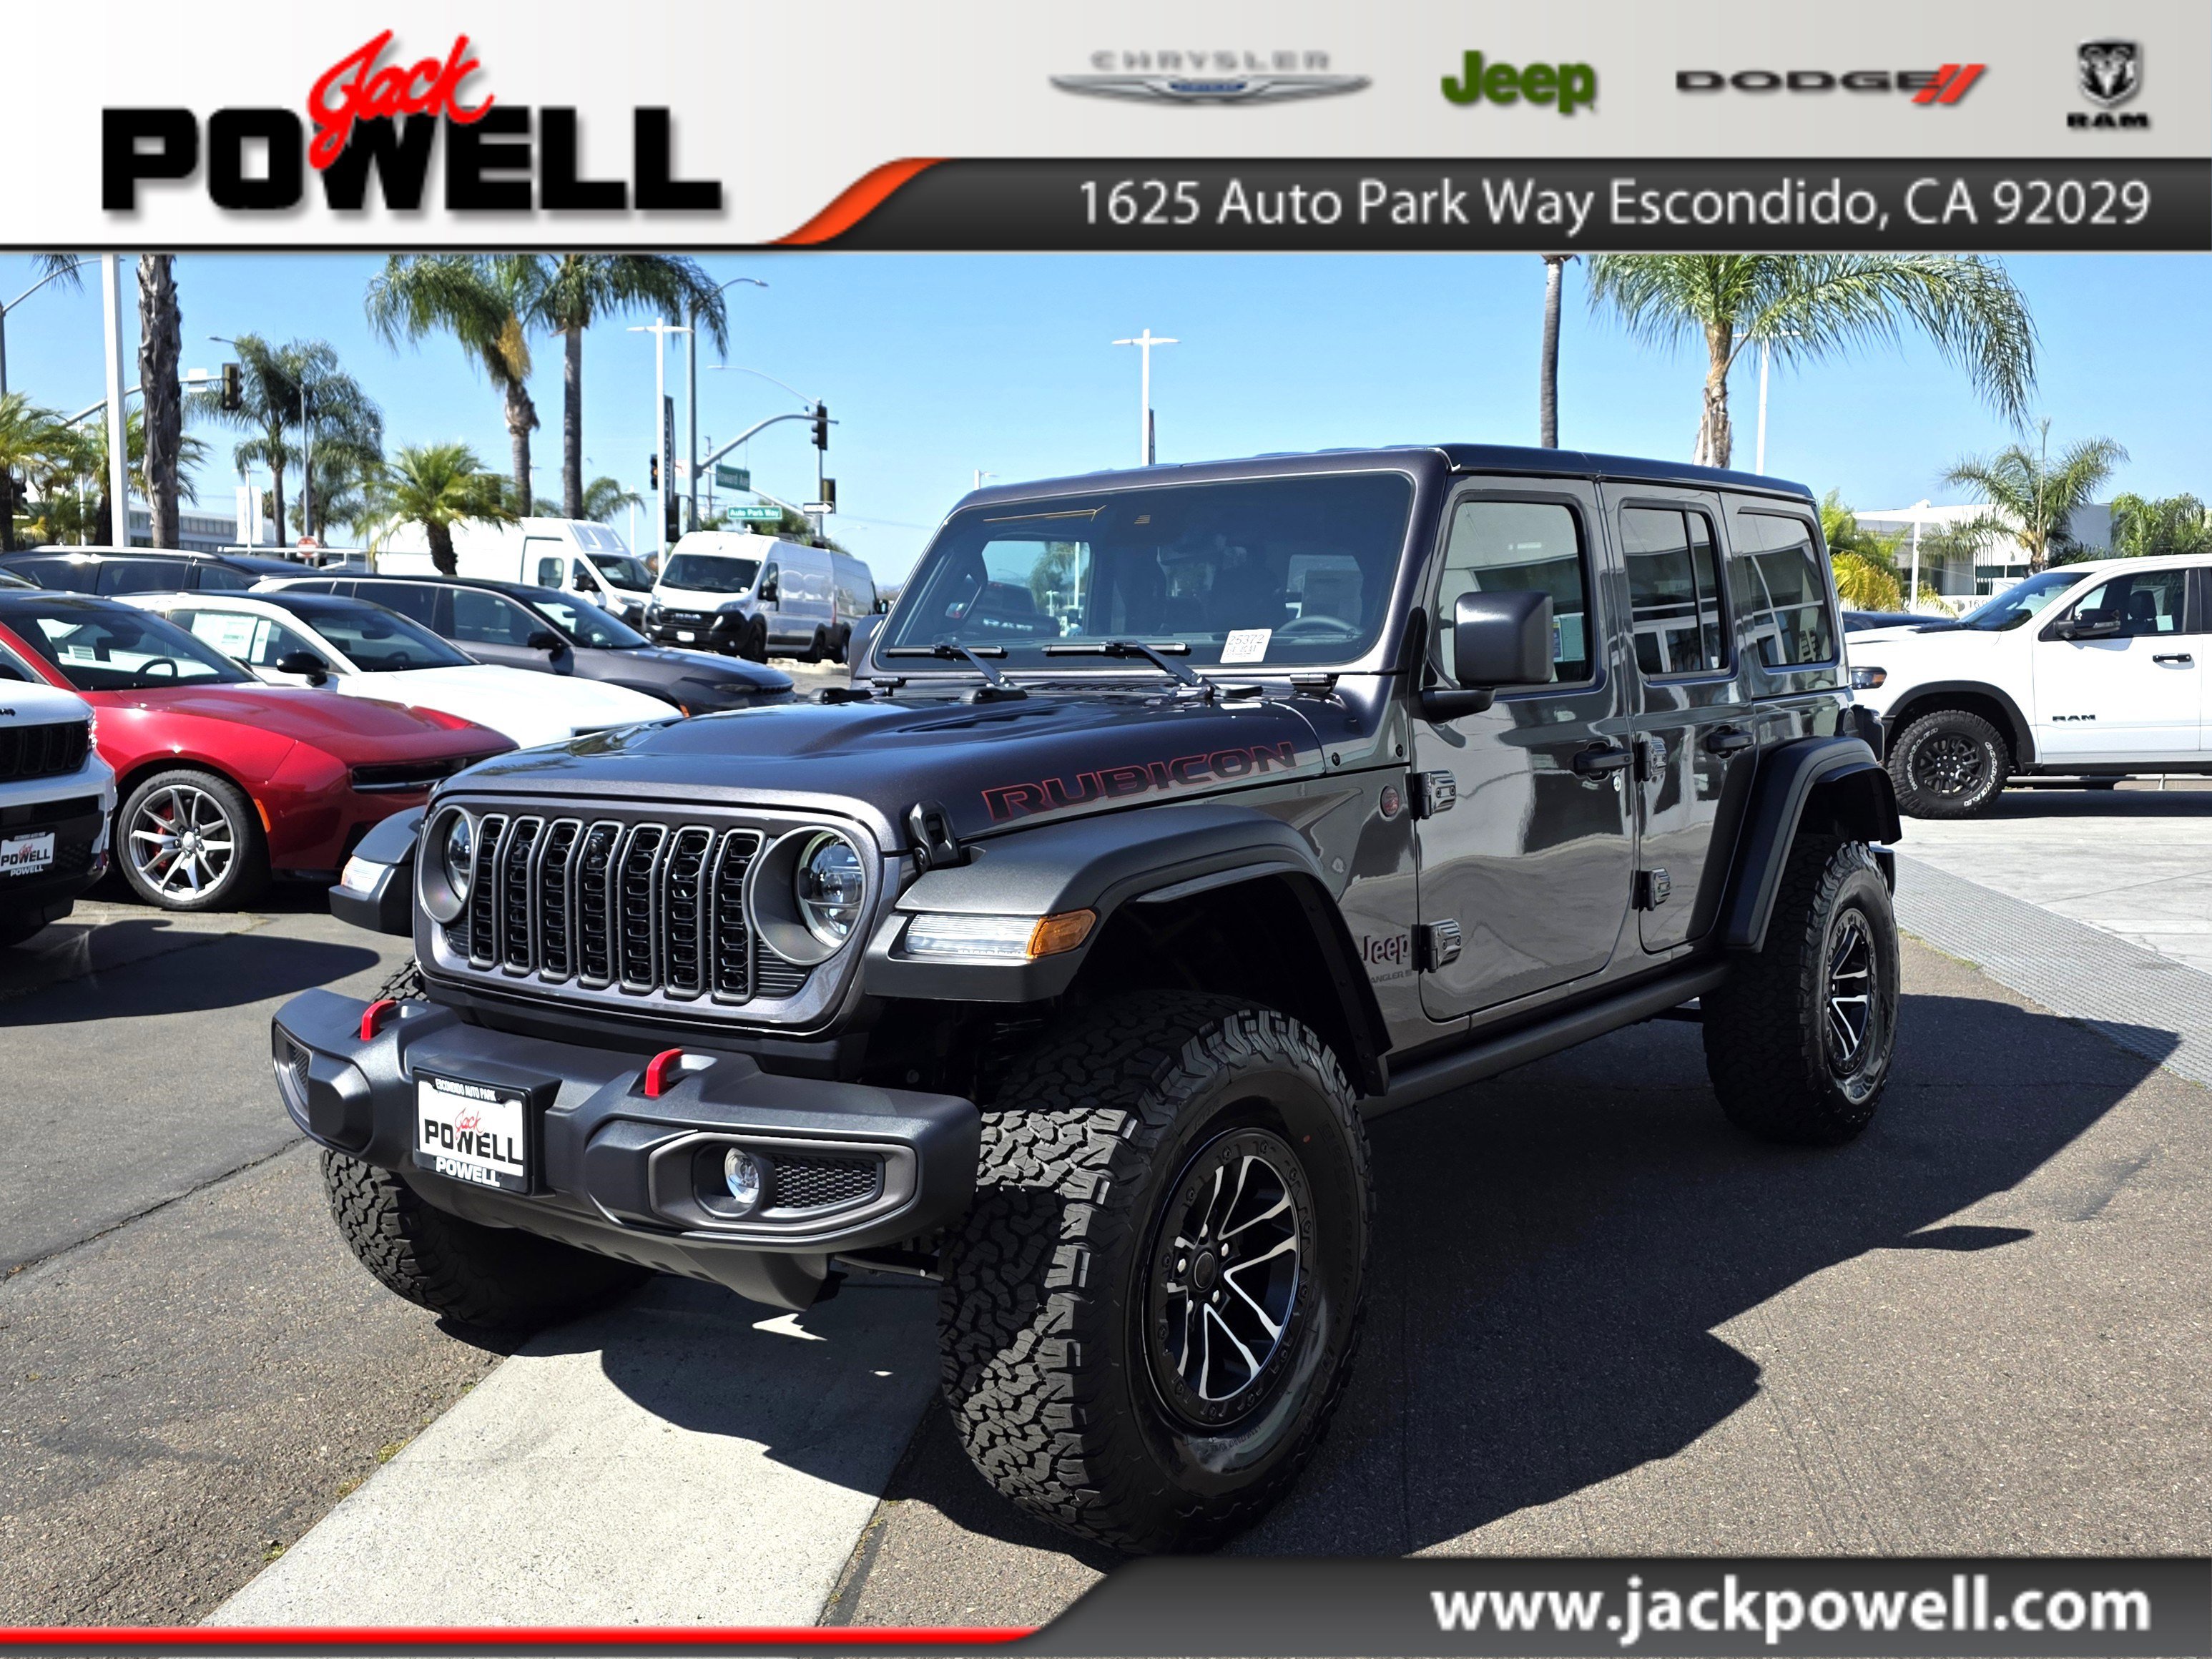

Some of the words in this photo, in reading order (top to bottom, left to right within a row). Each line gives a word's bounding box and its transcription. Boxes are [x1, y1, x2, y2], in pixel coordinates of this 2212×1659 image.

[1228, 634, 1264, 645] 25372
[982, 741, 1297, 822] RUBICON
[1963, 742, 1998, 807] GOODYEAR
[1, 848, 51, 867] POWELL
[10, 864, 44, 877] POWELL
[1359, 934, 1408, 965] Jeep
[465, 1085, 480, 1098] AUTO
[479, 1088, 496, 1102] PARK
[455, 1107, 486, 1141] Jack
[424, 1118, 523, 1165] POWELL
[436, 1155, 501, 1188] POWELL
